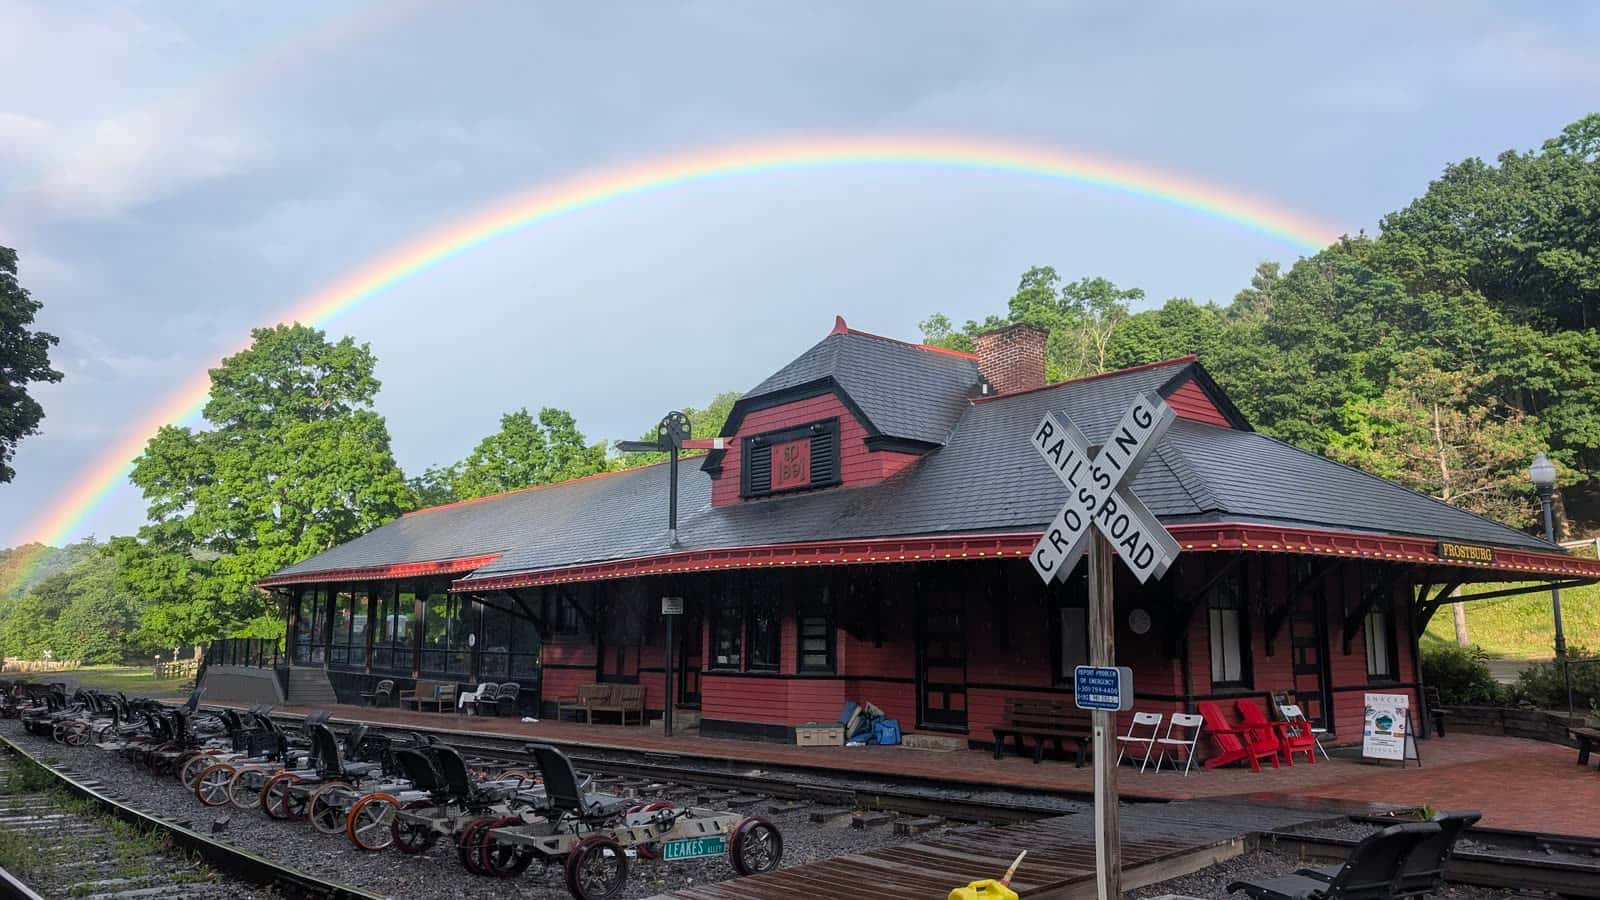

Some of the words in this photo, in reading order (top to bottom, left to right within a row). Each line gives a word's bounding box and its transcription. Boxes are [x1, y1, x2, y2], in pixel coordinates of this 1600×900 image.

[1035, 421, 1082, 488] RAIL
[1096, 496, 1154, 571] ROAD
[1036, 405, 1152, 572] CROSSING
[1442, 543, 1492, 561] FROSTBURG
[667, 839, 703, 857] LEAKES
